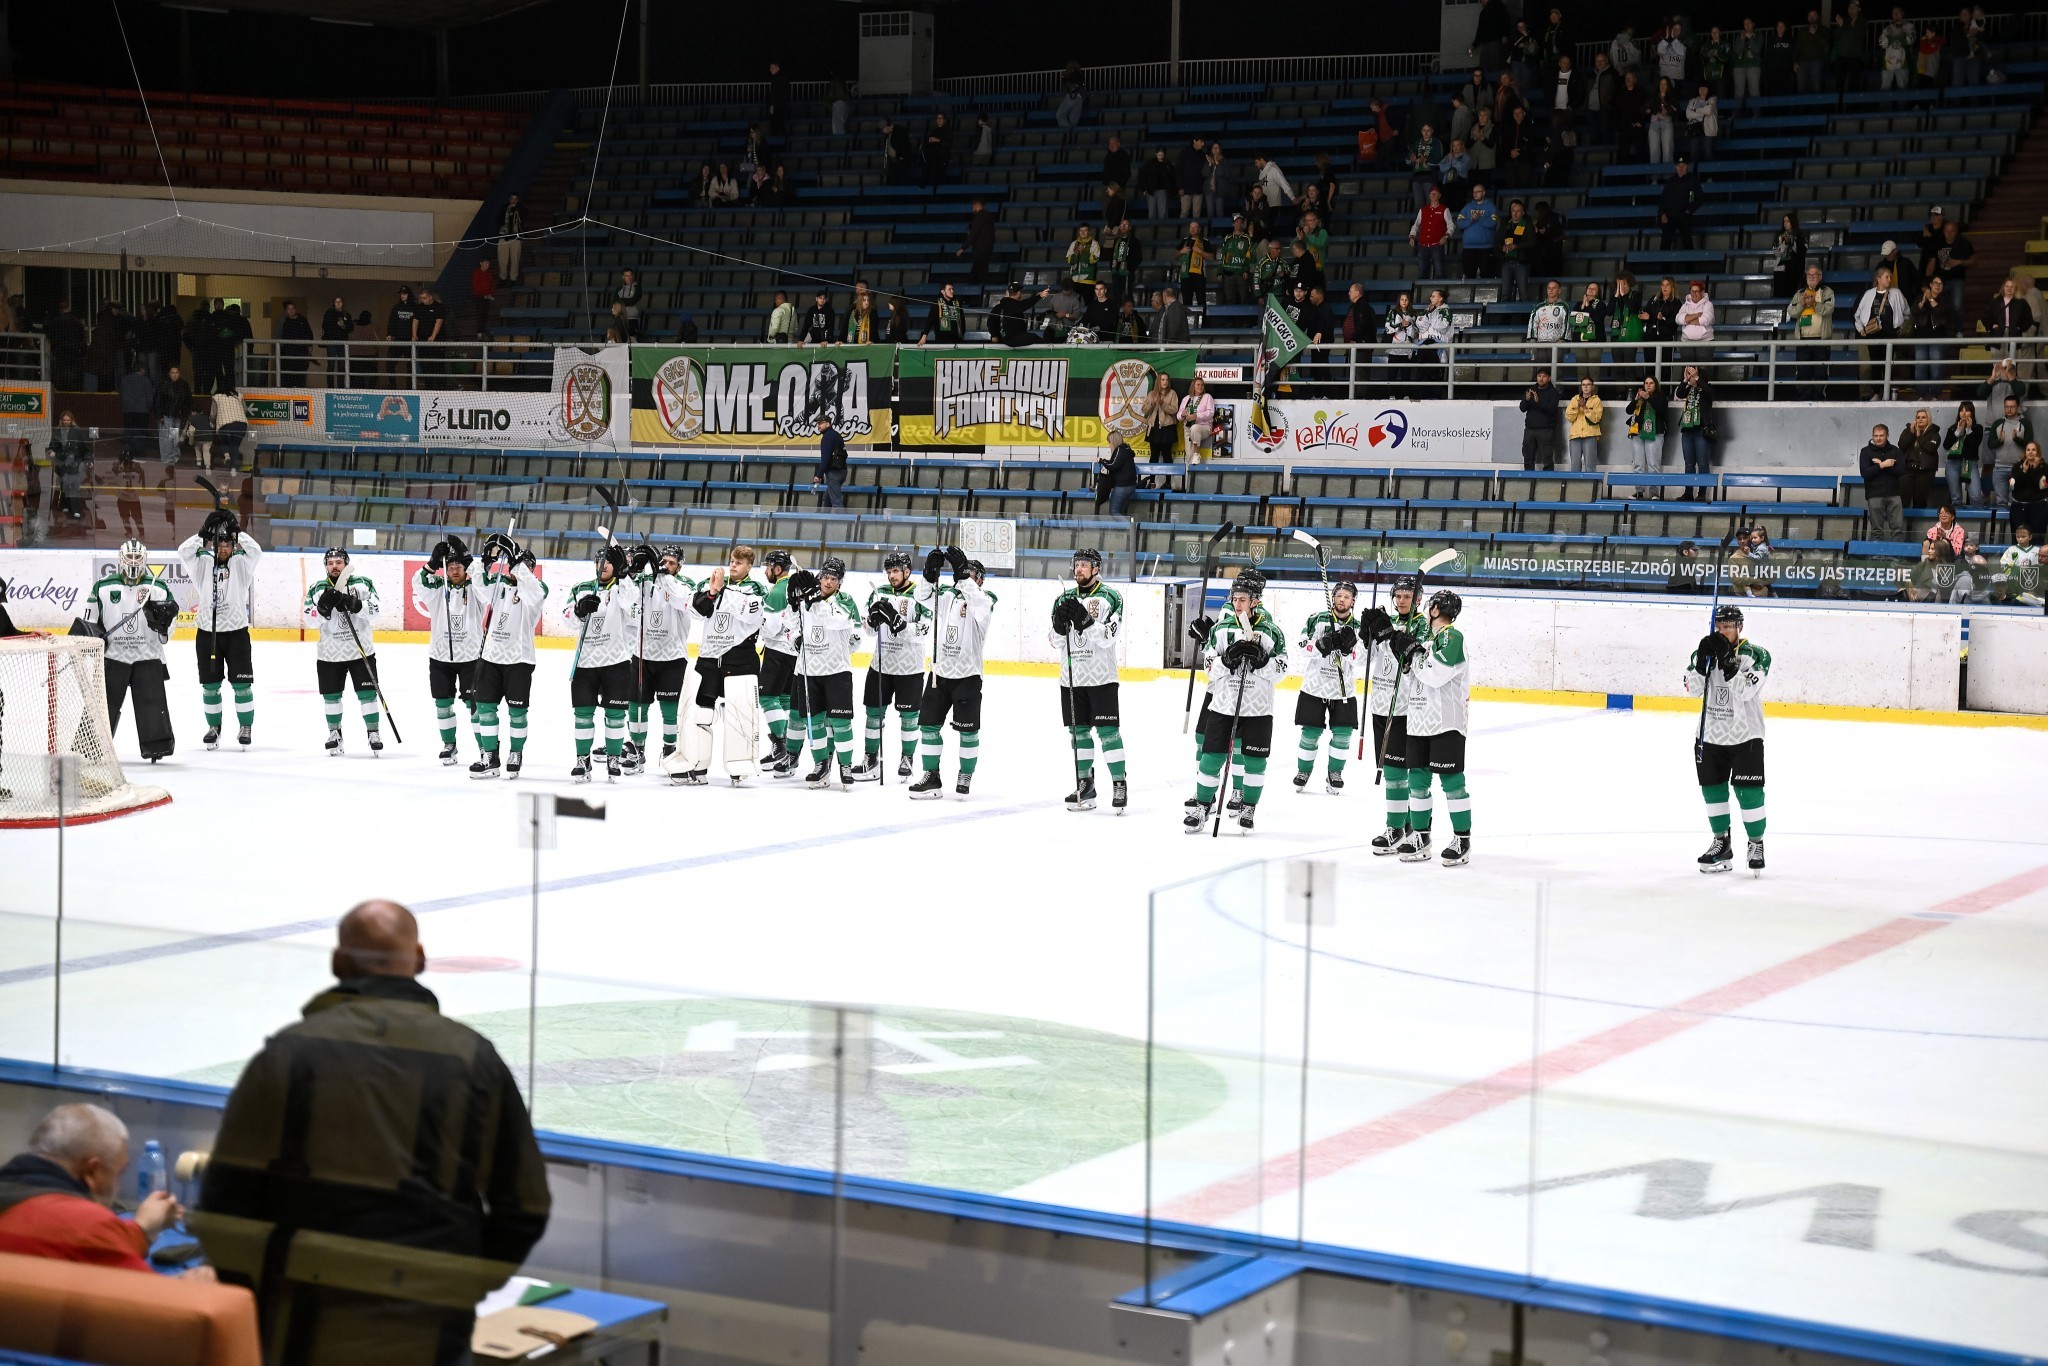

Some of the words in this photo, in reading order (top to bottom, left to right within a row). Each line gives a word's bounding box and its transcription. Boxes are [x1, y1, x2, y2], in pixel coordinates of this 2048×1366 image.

[1276, 323, 1292, 340] GKS
[1286, 340, 1295, 351] 63
[663, 359, 686, 382] GKS
[1119, 362, 1144, 379] GKS
[1208, 368, 1239, 378] KOUŘENÍ
[273, 402, 287, 410] EXIT
[295, 405, 308, 416] WC
[260, 409, 287, 418] VÝCHOD
[448, 409, 511, 430] LUMO
[1411, 427, 1491, 440] Moravskoslezský
[1411, 438, 1429, 451] kraj
[1484, 556, 1538, 572] MIASTO
[1541, 557, 1676, 577] JASTRZĘBIE-ZDRÓJ
[1680, 563, 1750, 578] WSPIERA
[1753, 565, 1780, 579] JKH
[1785, 565, 1816, 580] GKS
[1820, 566, 1912, 585] JASTRZĘBIE
[218, 573, 223, 582] A
[6, 577, 79, 611] hockey
[1385, 753, 1405, 761] AUER
